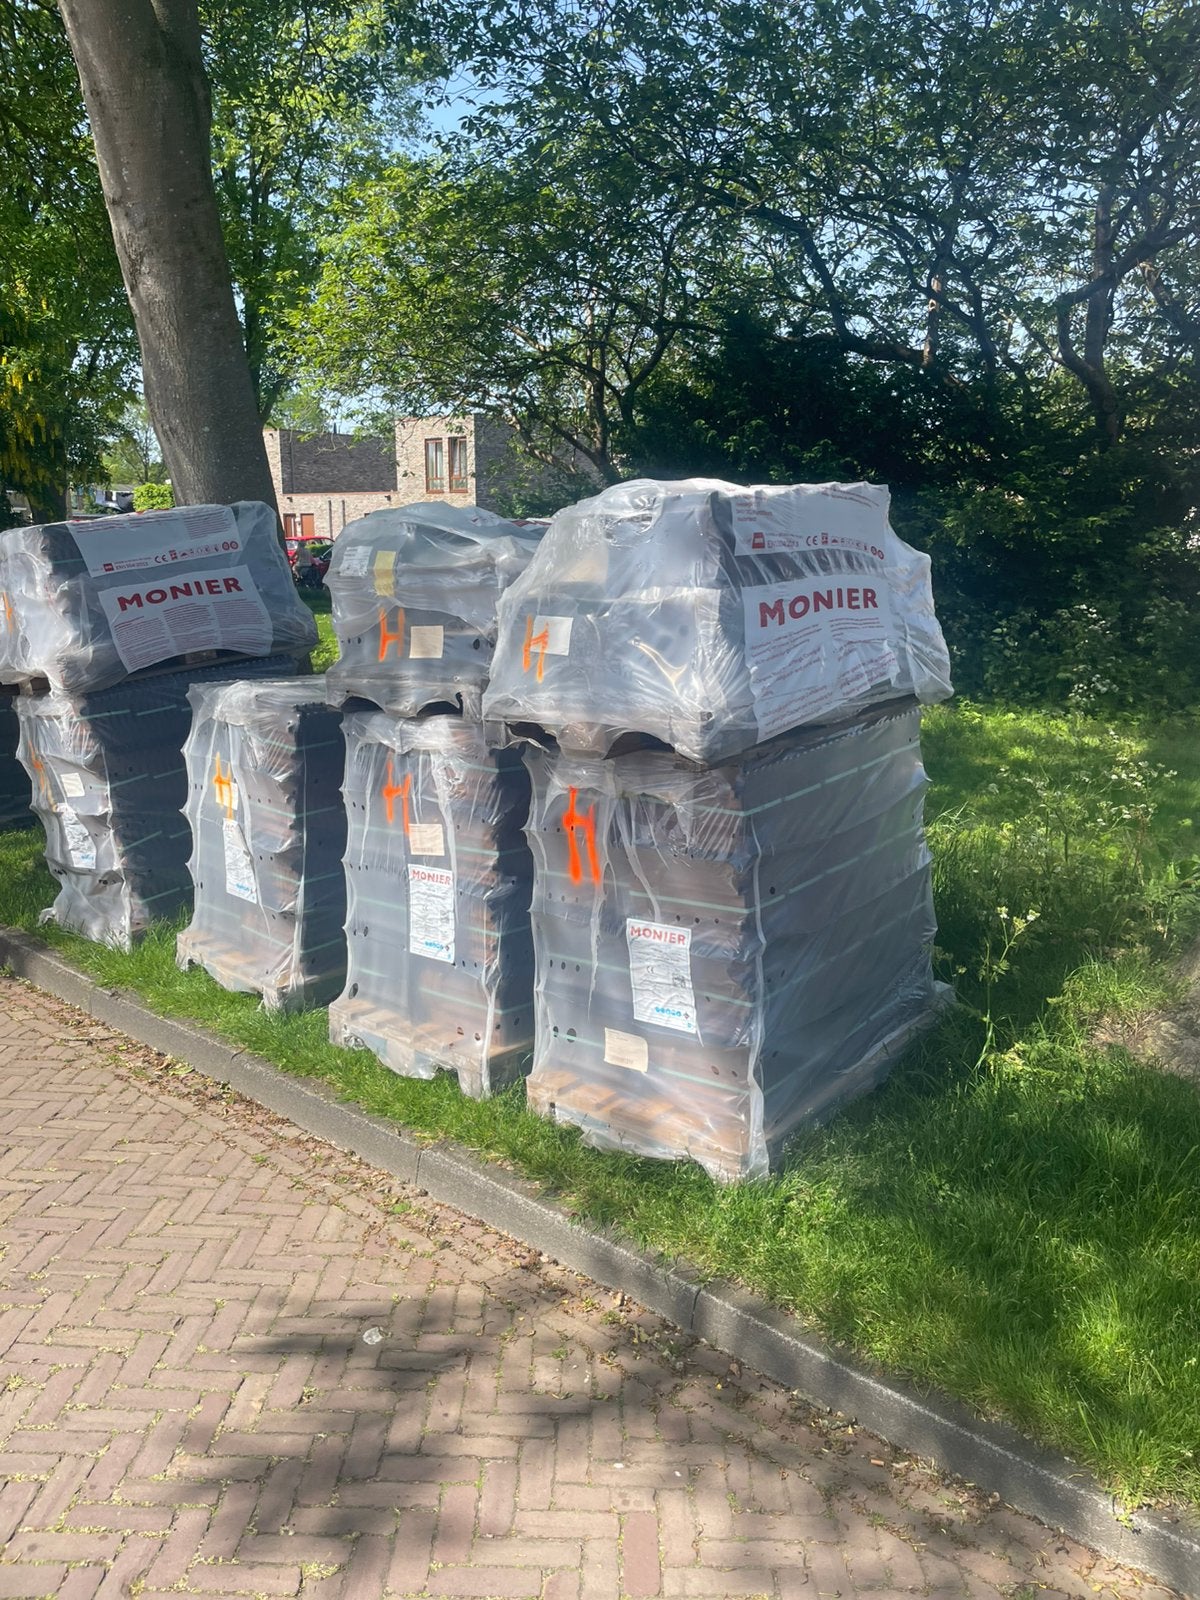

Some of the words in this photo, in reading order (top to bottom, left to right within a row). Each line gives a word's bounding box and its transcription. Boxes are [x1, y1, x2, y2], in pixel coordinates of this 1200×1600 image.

[117, 577, 243, 612] MONIER
[759, 588, 878, 627] MONIER
[412, 869, 452, 886] MONIER
[630, 926, 686, 945] MONIER
